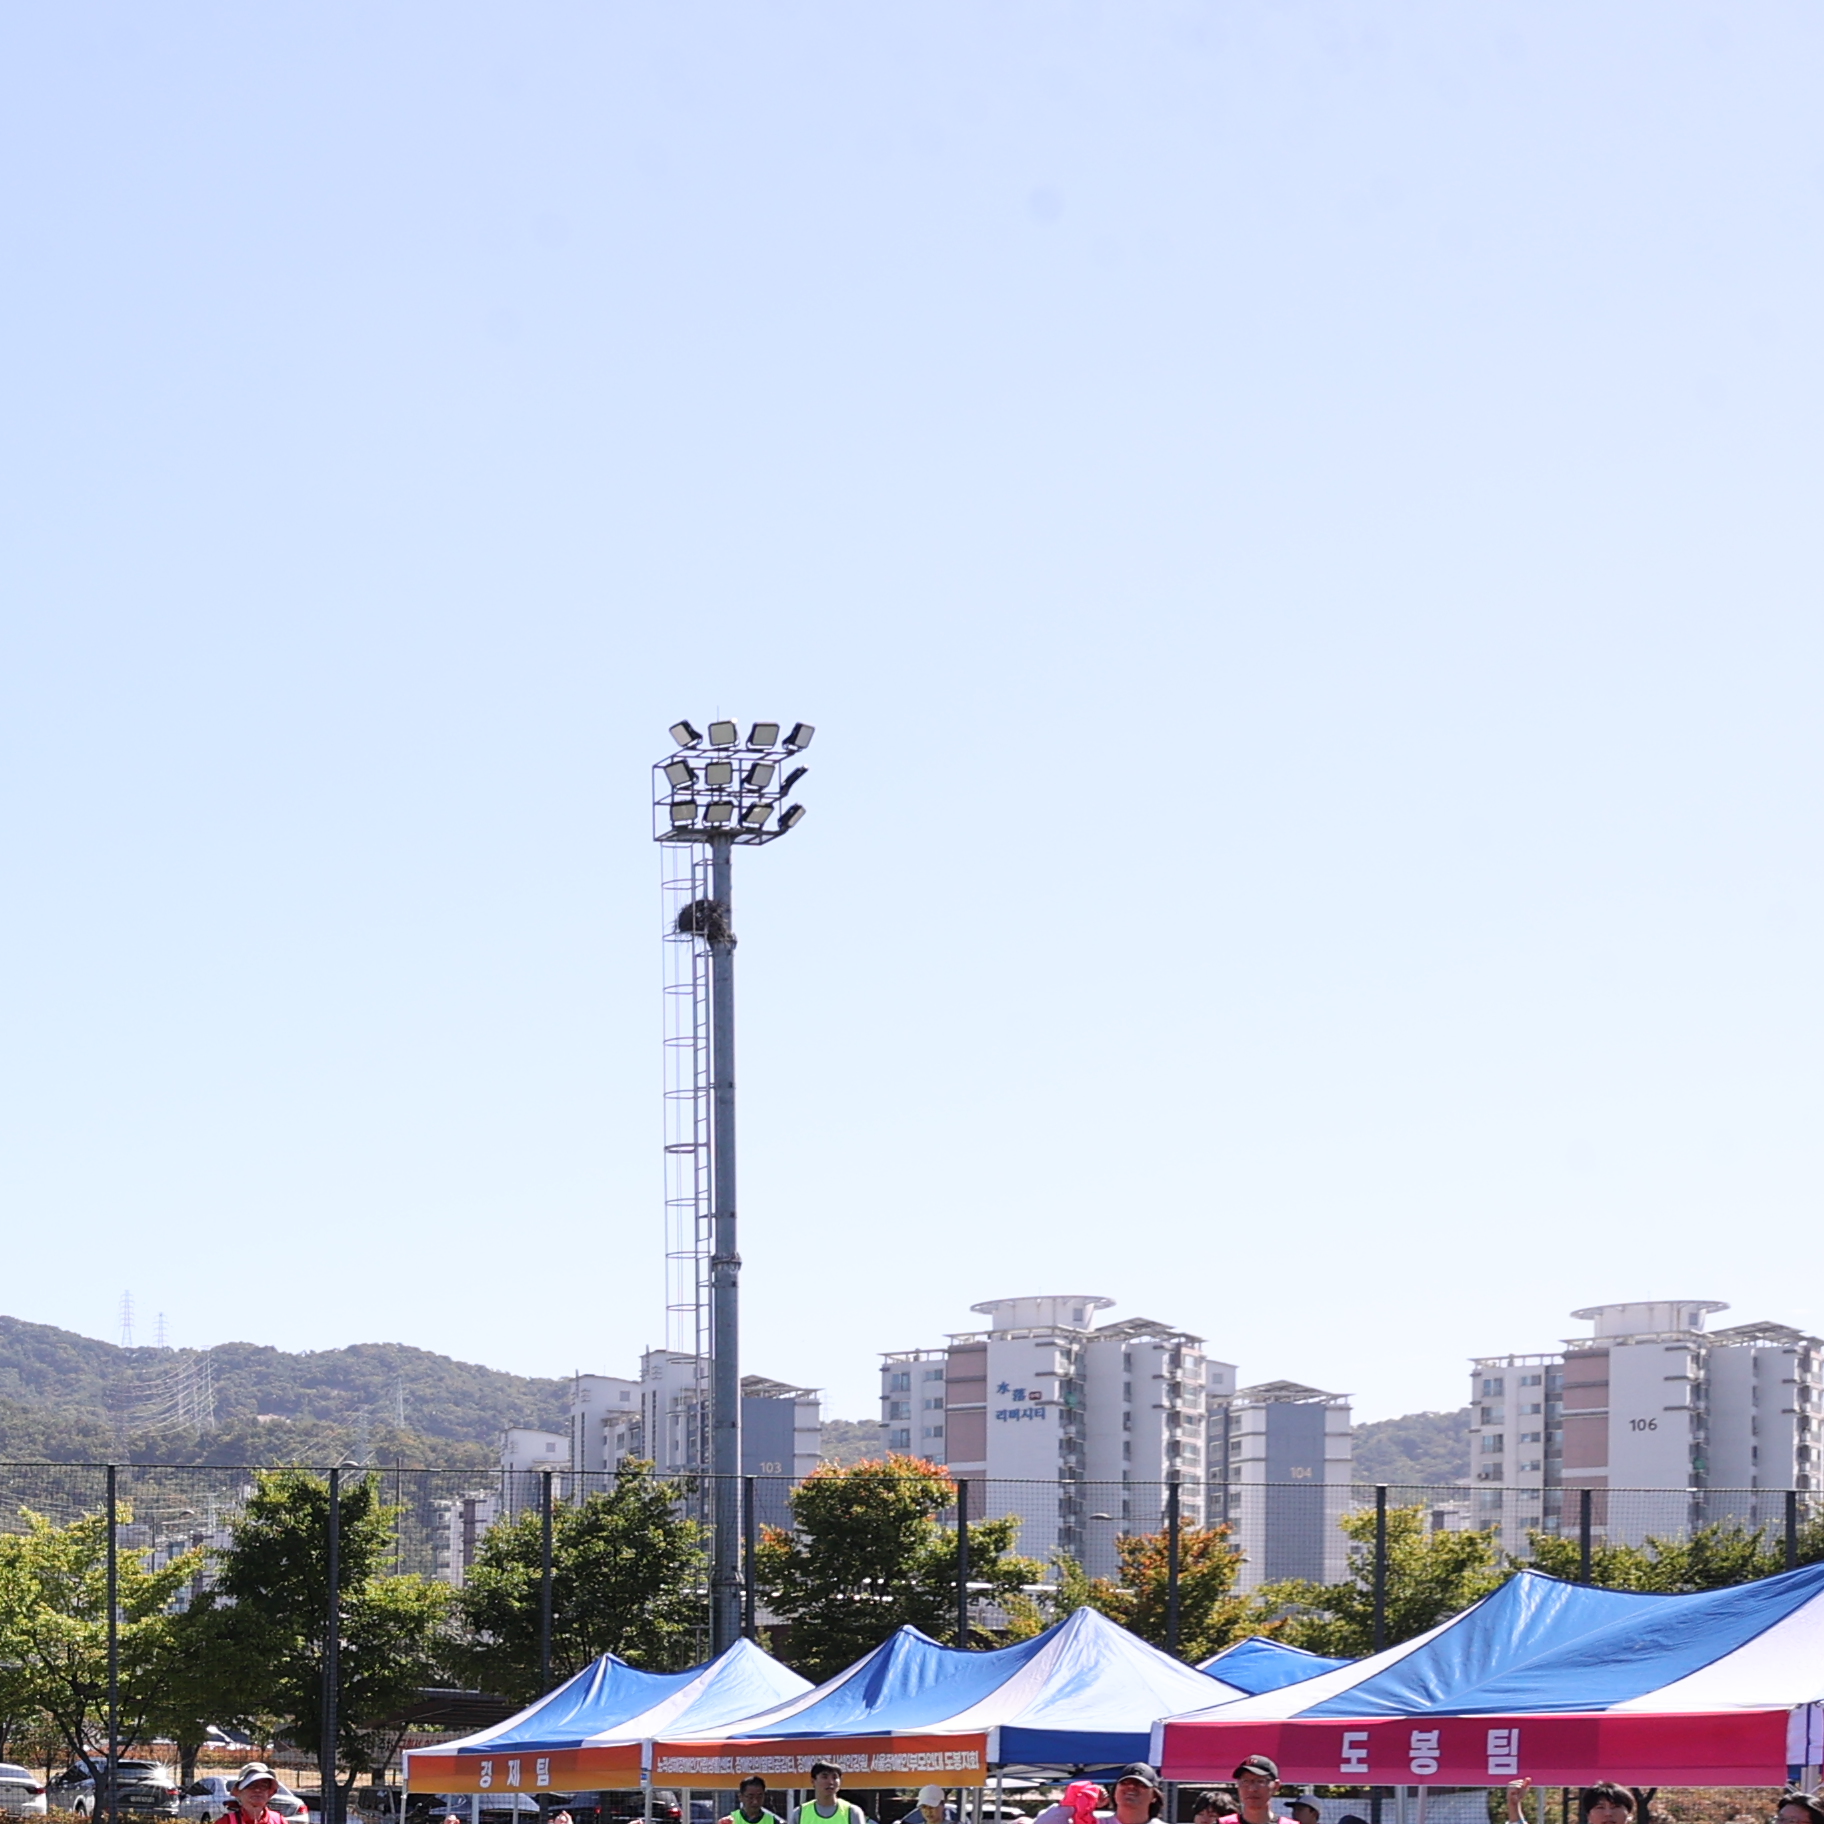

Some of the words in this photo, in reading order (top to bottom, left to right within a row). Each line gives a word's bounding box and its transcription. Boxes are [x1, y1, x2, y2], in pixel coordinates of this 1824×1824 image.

[995, 1406, 1046, 1422] 리버시티
[1628, 1418, 1658, 1432] 106
[759, 1462, 783, 1474] 103
[1290, 1466, 1313, 1479] 104
[1340, 1728, 1520, 1776] 도봉팀
[479, 1757, 551, 1788] 경제팀
